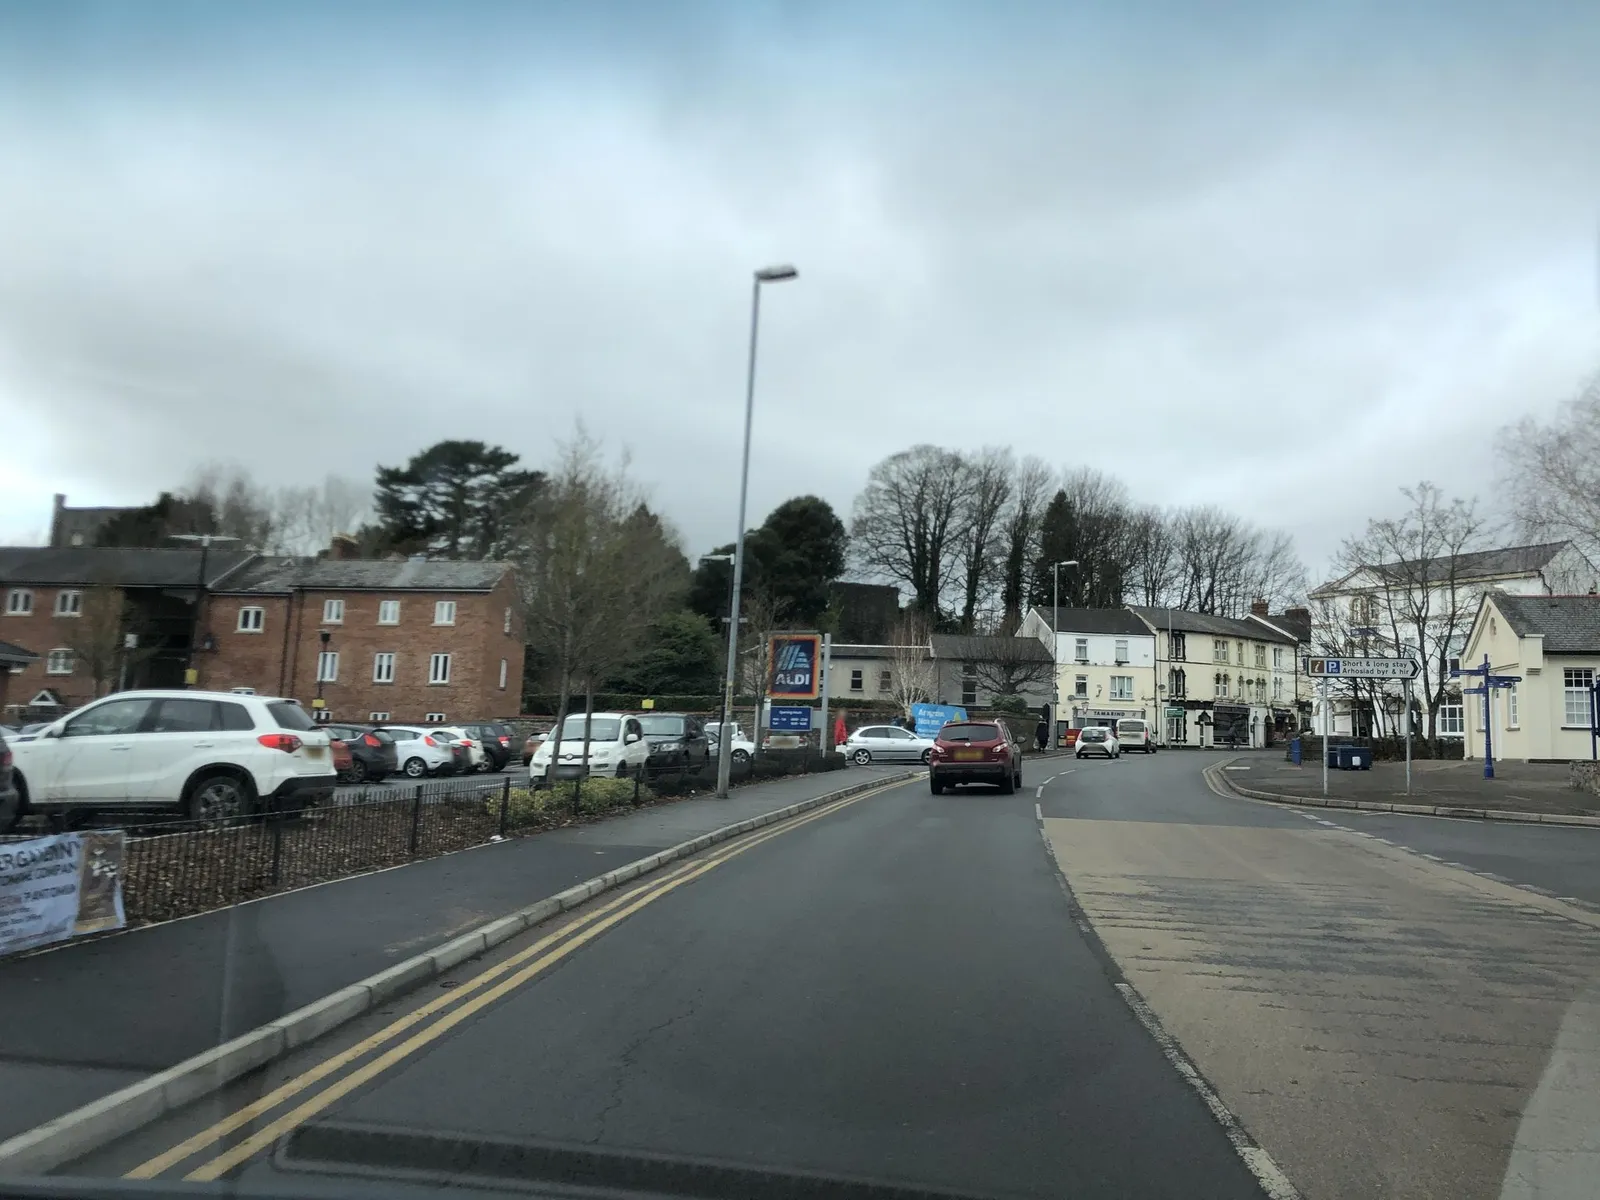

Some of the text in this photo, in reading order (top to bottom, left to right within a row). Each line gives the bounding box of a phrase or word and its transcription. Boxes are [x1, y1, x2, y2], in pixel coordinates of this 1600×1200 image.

[1373, 660, 1389, 669] long
[1376, 667, 1388, 675] byr
[775, 673, 810, 685] ALDI
